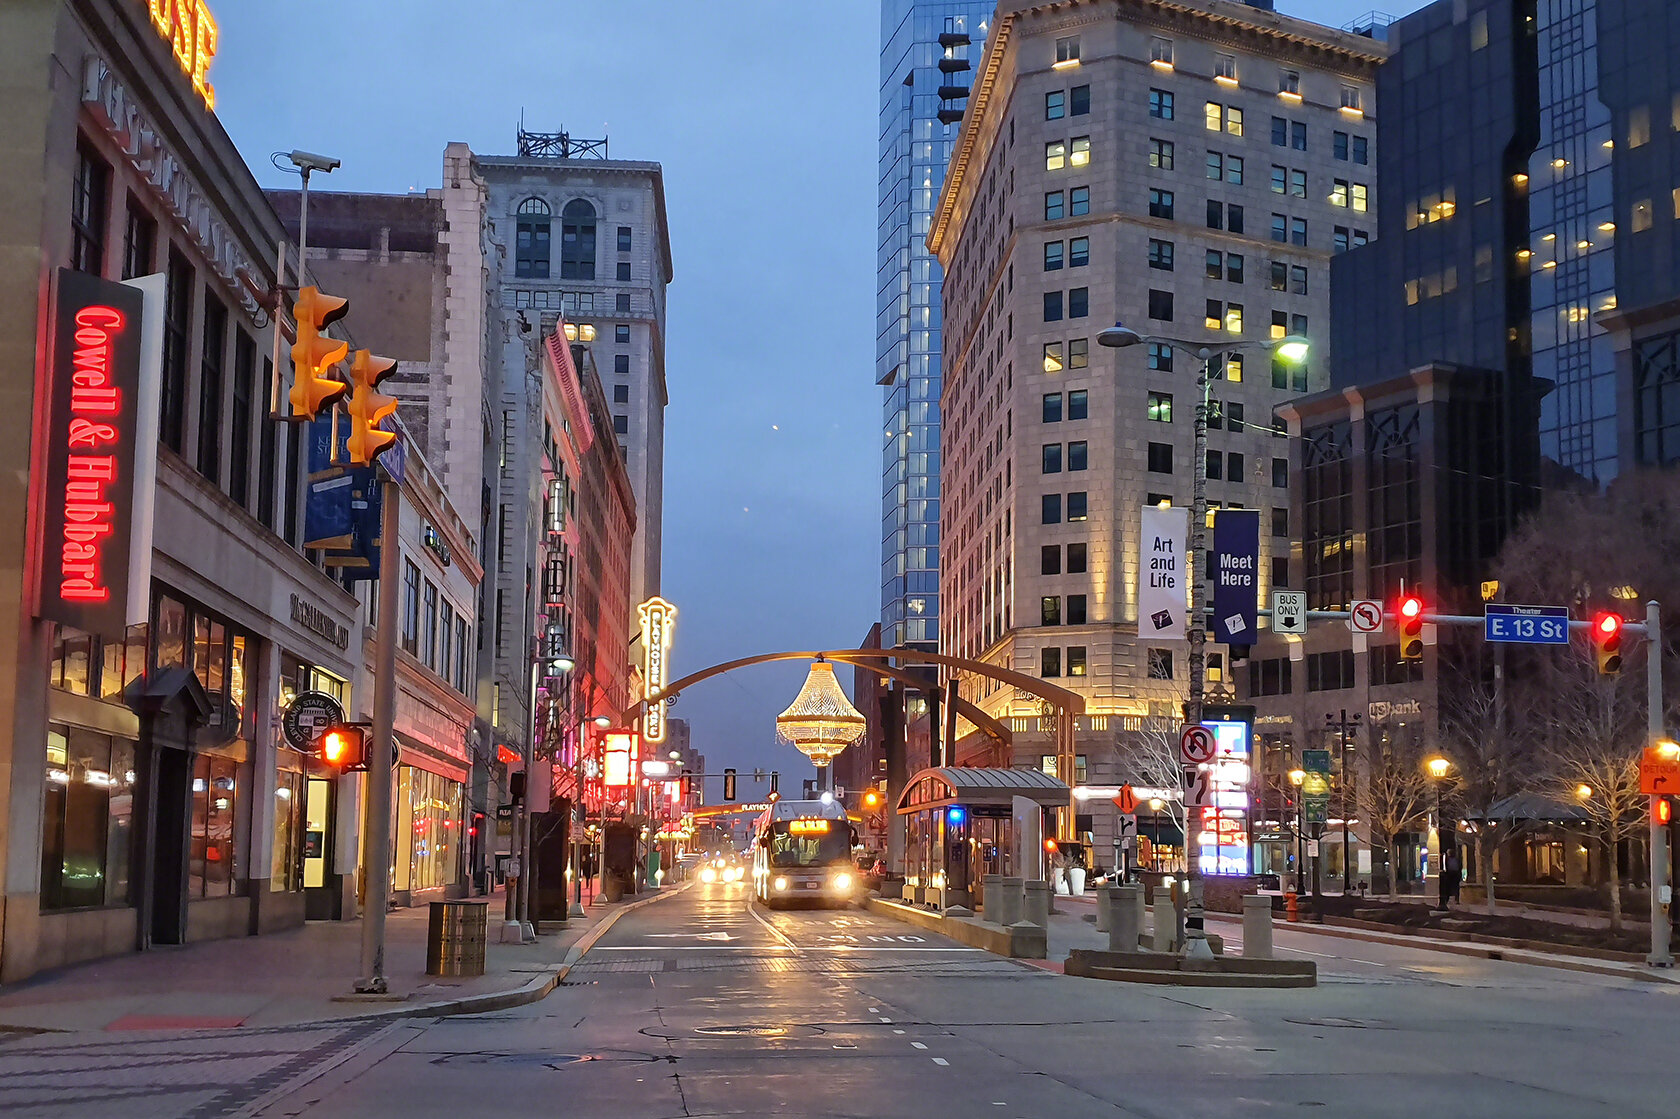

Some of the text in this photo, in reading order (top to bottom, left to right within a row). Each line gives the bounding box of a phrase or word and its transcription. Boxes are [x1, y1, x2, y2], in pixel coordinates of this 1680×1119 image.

[61, 306, 121, 598] Cowell & Hubbard
[1153, 536, 1173, 553] Art
[1150, 556, 1175, 571] and
[1220, 553, 1252, 569] Meet
[1150, 572, 1175, 588] Life
[1220, 571, 1251, 586] Here
[1279, 595, 1298, 605] BUS
[1277, 605, 1300, 616] ONLY
[1512, 606, 1542, 615] Theater
[1492, 618, 1563, 638] E. 13 St
[648, 611, 661, 736] PLAYHOUSE SUARE
[289, 699, 338, 742] CLEVELAND STATE UNIVE
[1643, 764, 1678, 774] DETOUR
[741, 803, 773, 812] PLAYHOU
